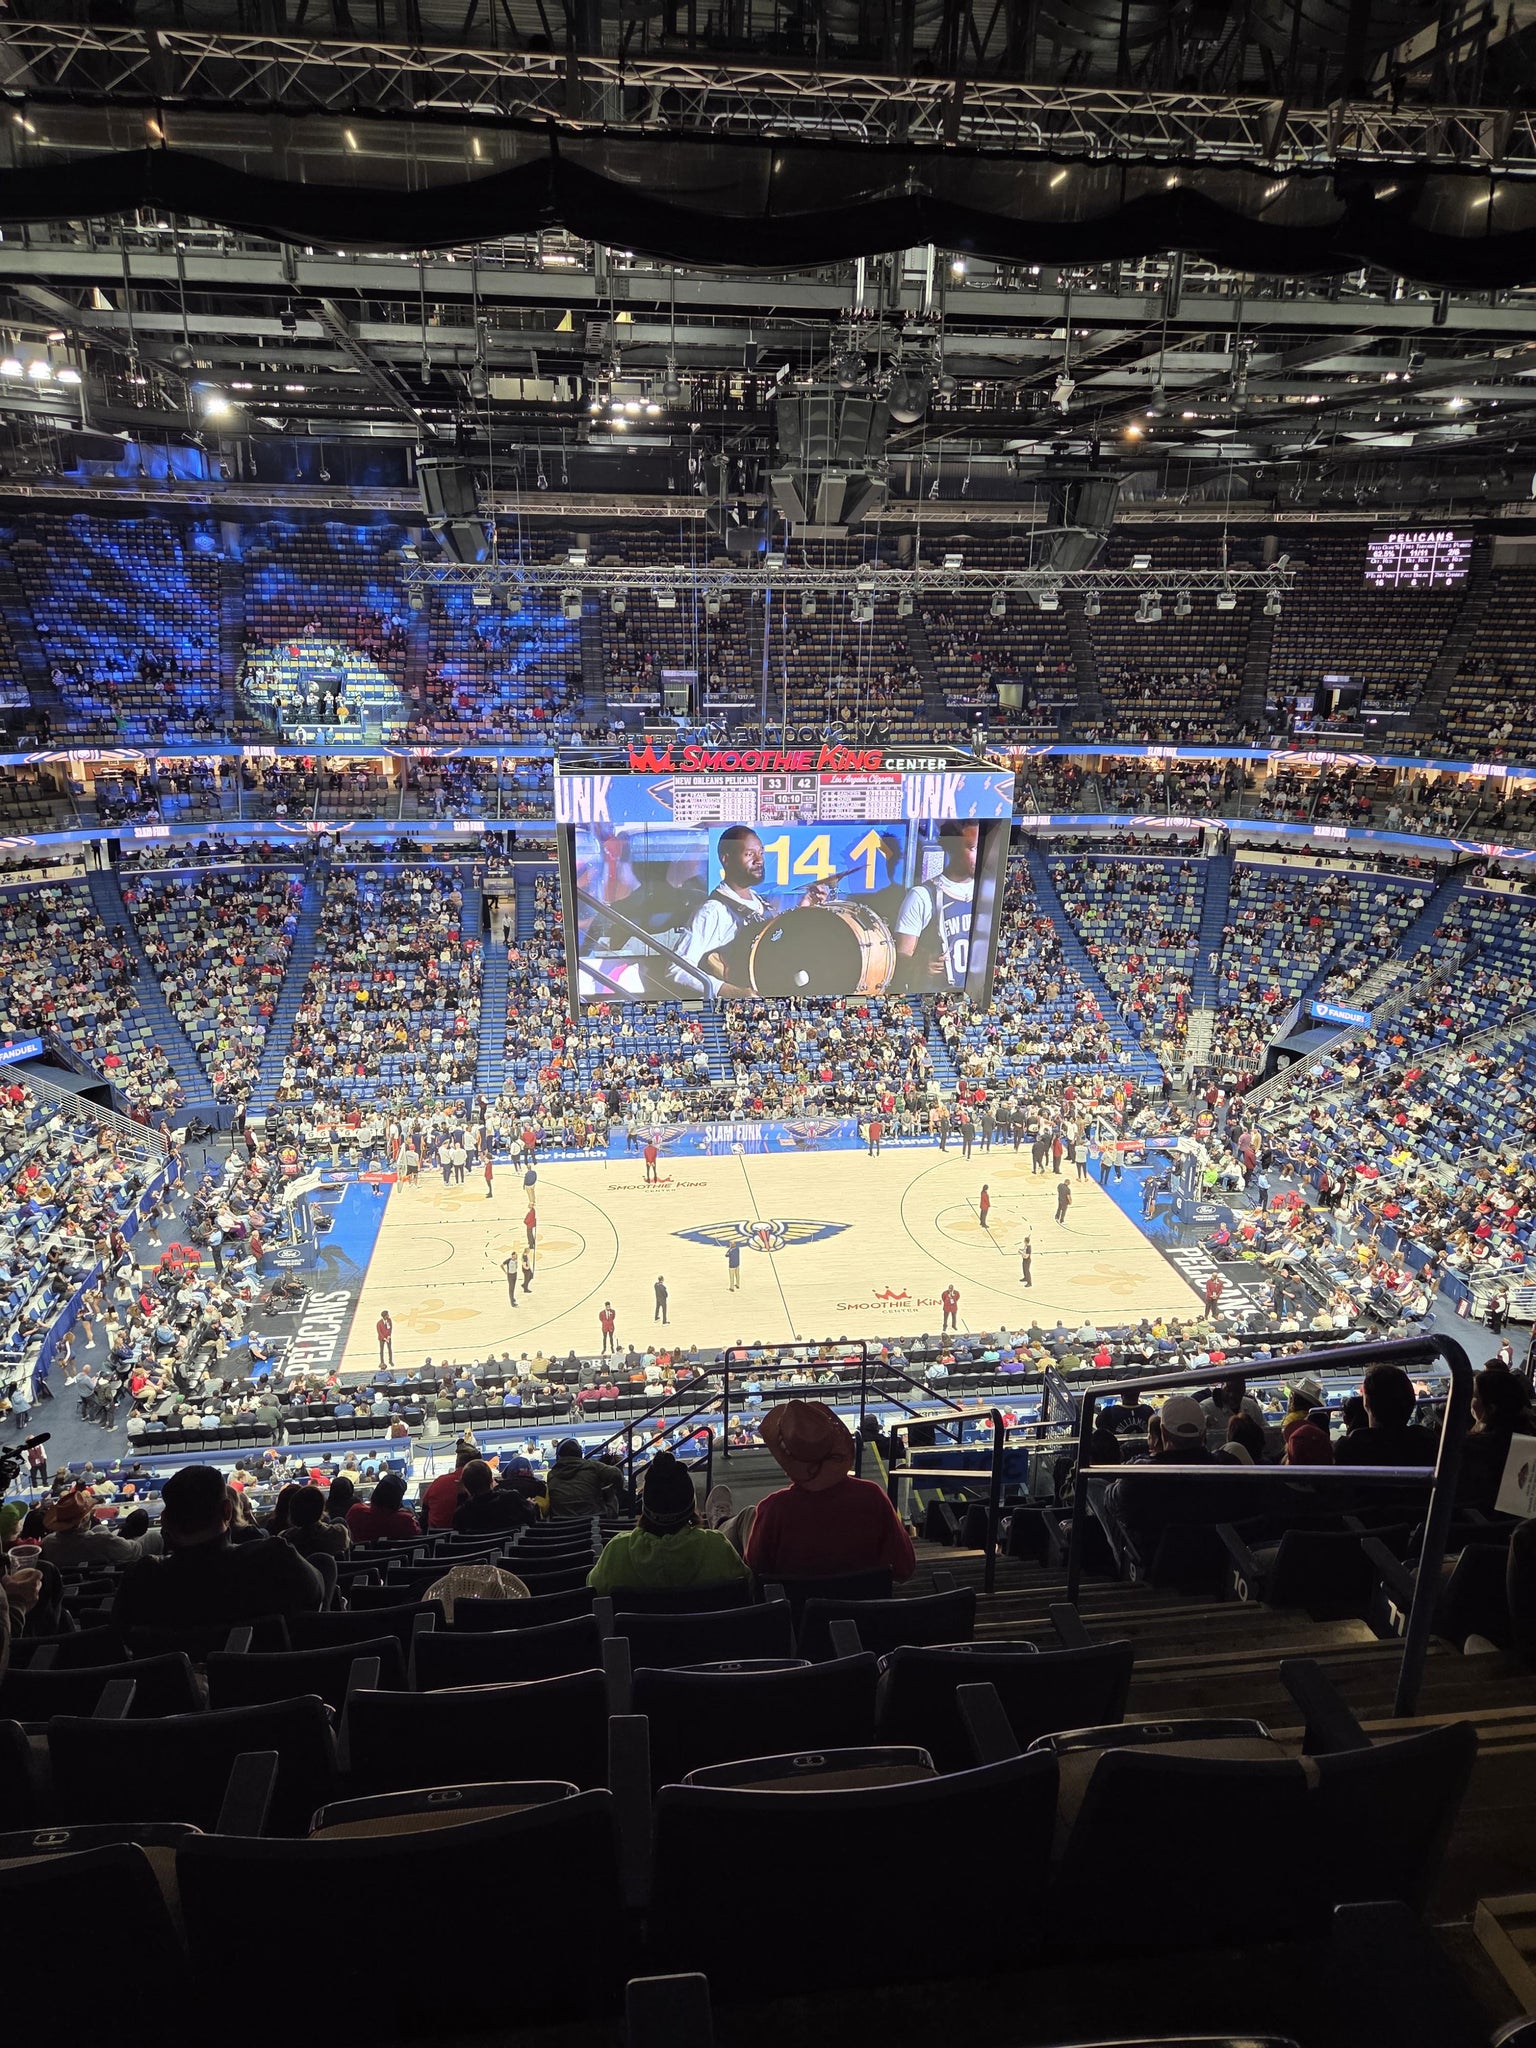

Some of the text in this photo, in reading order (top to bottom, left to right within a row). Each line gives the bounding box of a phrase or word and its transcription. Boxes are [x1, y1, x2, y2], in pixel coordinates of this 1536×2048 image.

[1389, 532, 1454, 542] PELICANS
[680, 745, 815, 771] SMOOTHIE
[885, 758, 947, 770] CENTER
[675, 777, 757, 785] NEW ORLEANS PELICANS
[769, 779, 781, 788] 33
[798, 779, 811, 788] 42
[830, 774, 894, 785] Los Angeles Clippers
[778, 795, 800, 803] 10:10
[764, 834, 837, 886] 14
[705, 1125, 734, 1142] SLAM
[554, 1150, 607, 1160] Health
[607, 1183, 673, 1191] SMOOTHIE
[836, 1300, 912, 1311] SMOOTHIE
[284, 1290, 351, 1377] PELICANS
[1233, 1569, 1248, 1602] 10
[1387, 1600, 1406, 1637] 11
